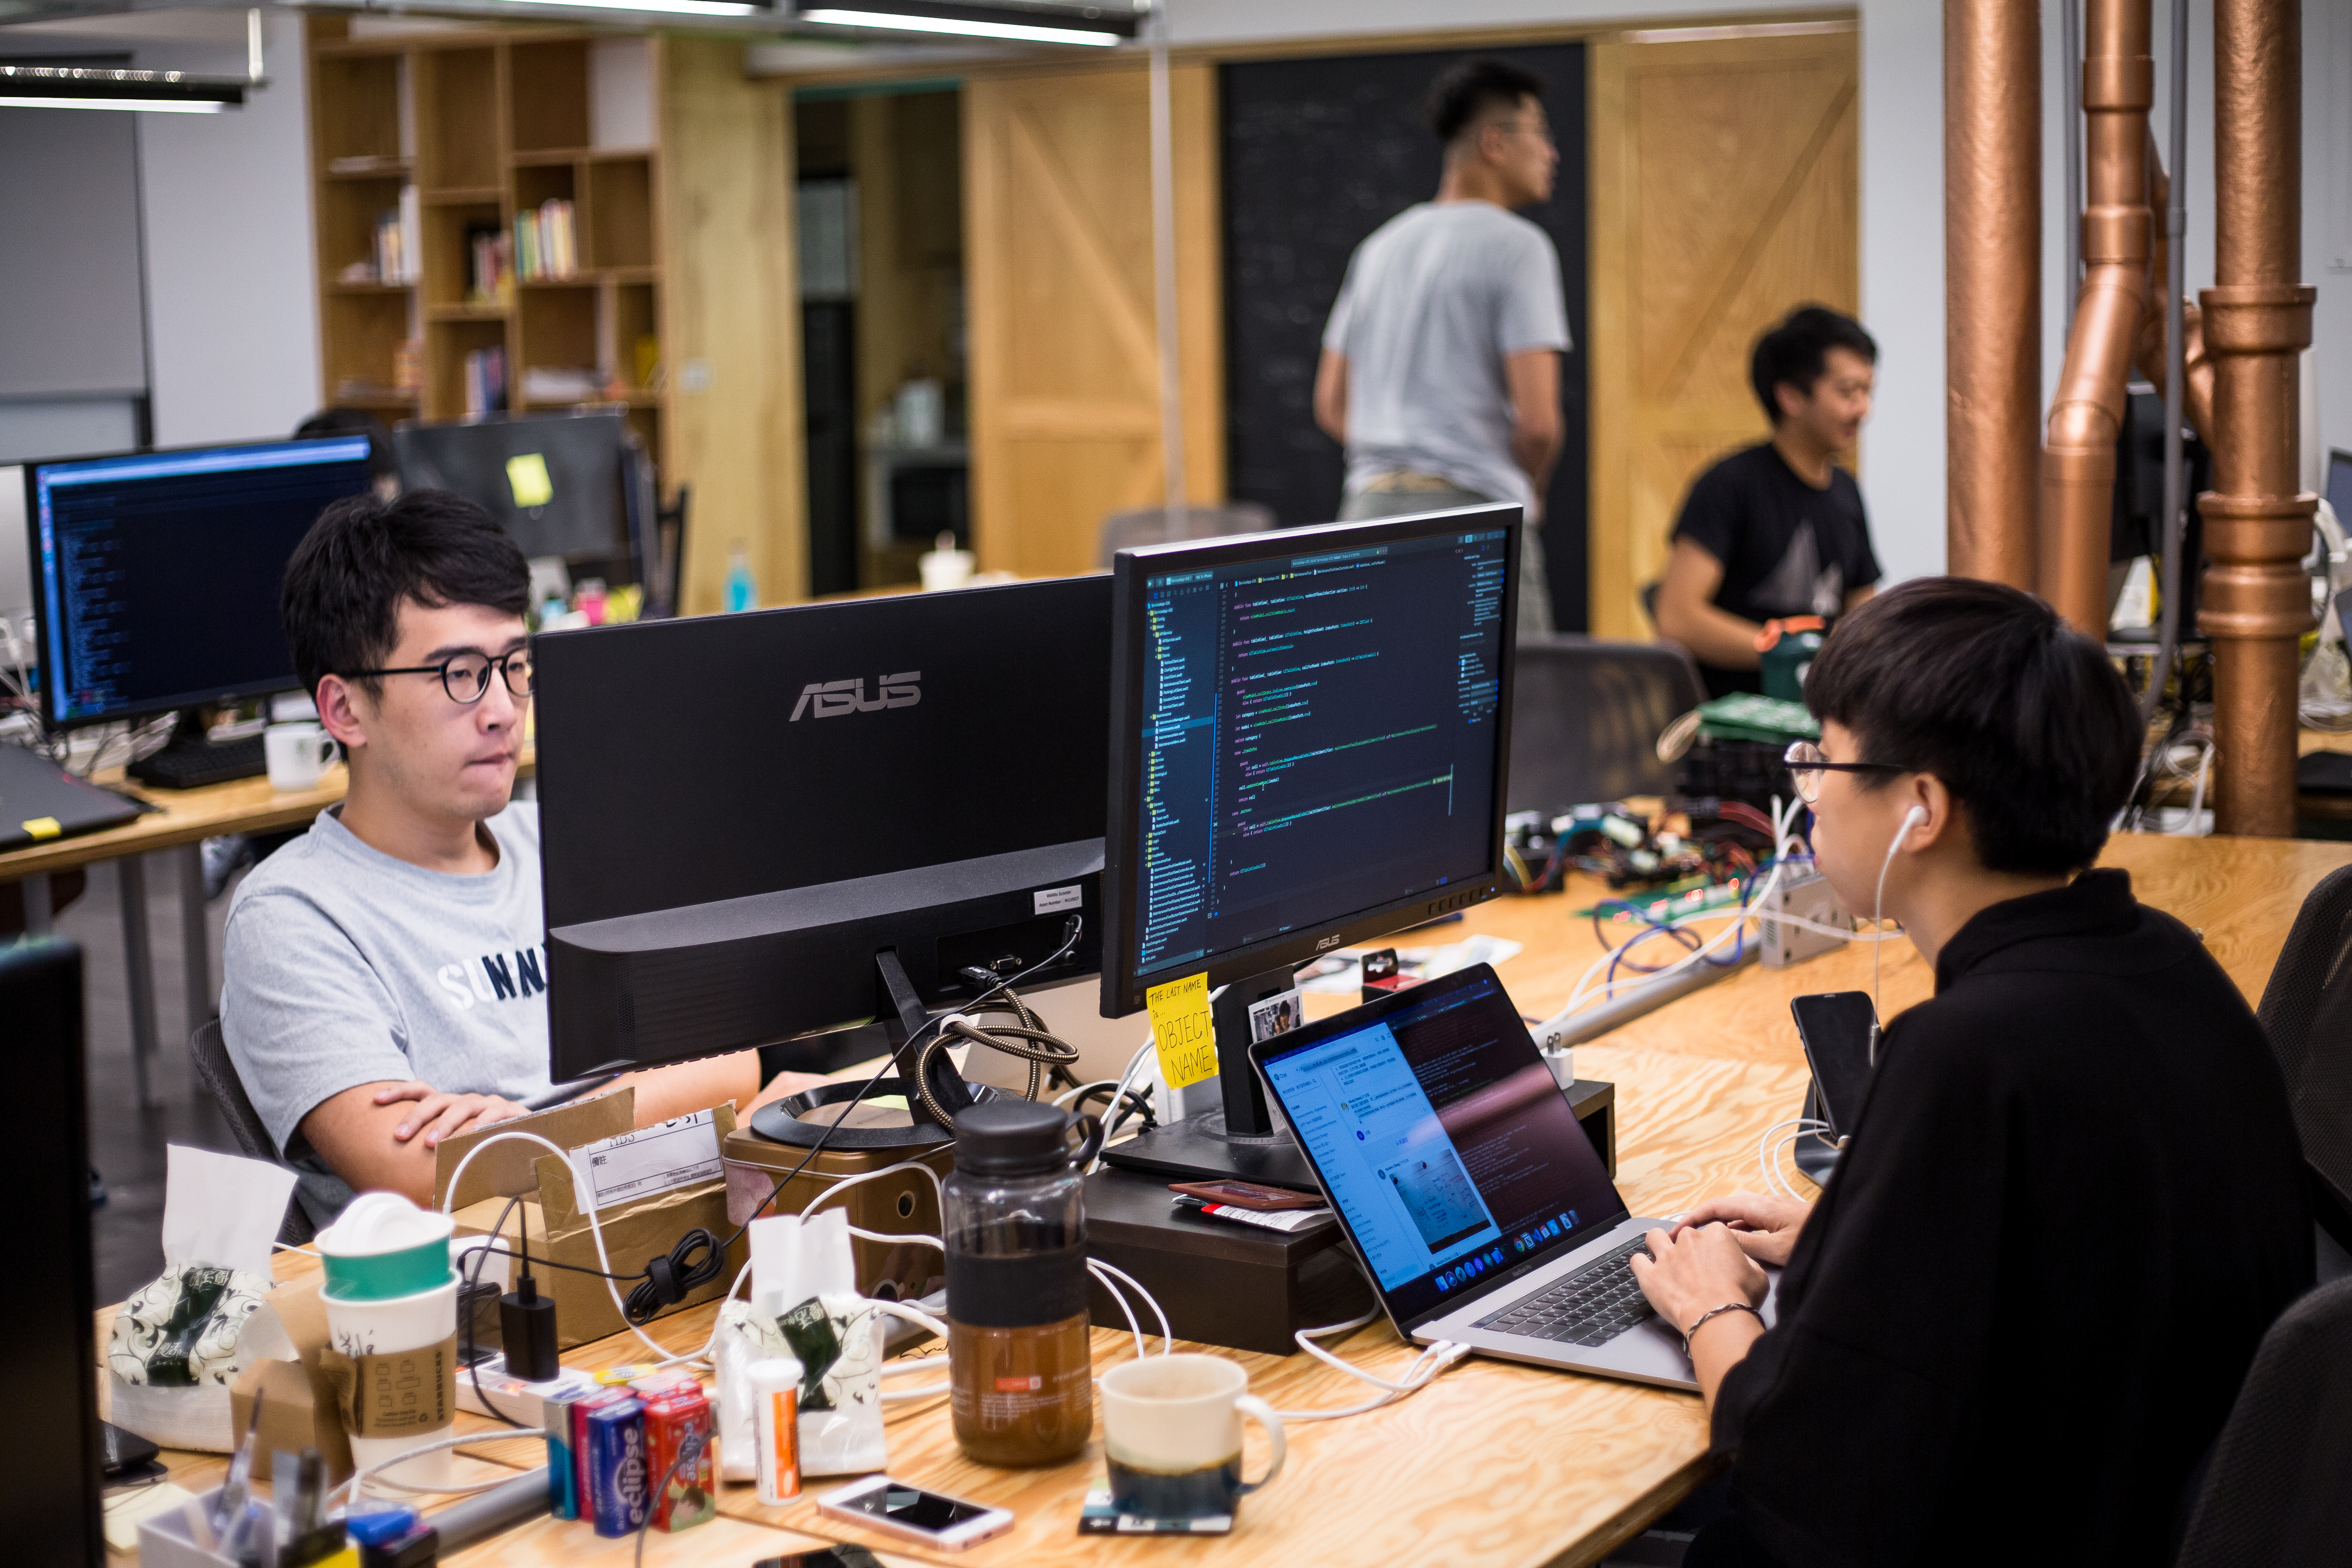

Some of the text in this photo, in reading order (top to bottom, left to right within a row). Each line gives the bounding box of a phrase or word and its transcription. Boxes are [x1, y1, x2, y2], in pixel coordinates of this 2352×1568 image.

[789, 671, 921, 722] ASUS
[1316, 934, 1340, 951] ASUS
[437, 942, 547, 1010] SUNN
[1149, 979, 1201, 1005] THE LAST NAME
[1158, 1011, 1209, 1051] OBJECT
[1171, 1045, 1212, 1085] NAME
[592, 1155, 608, 1168] 備註
[622, 1428, 648, 1524] eclipse
